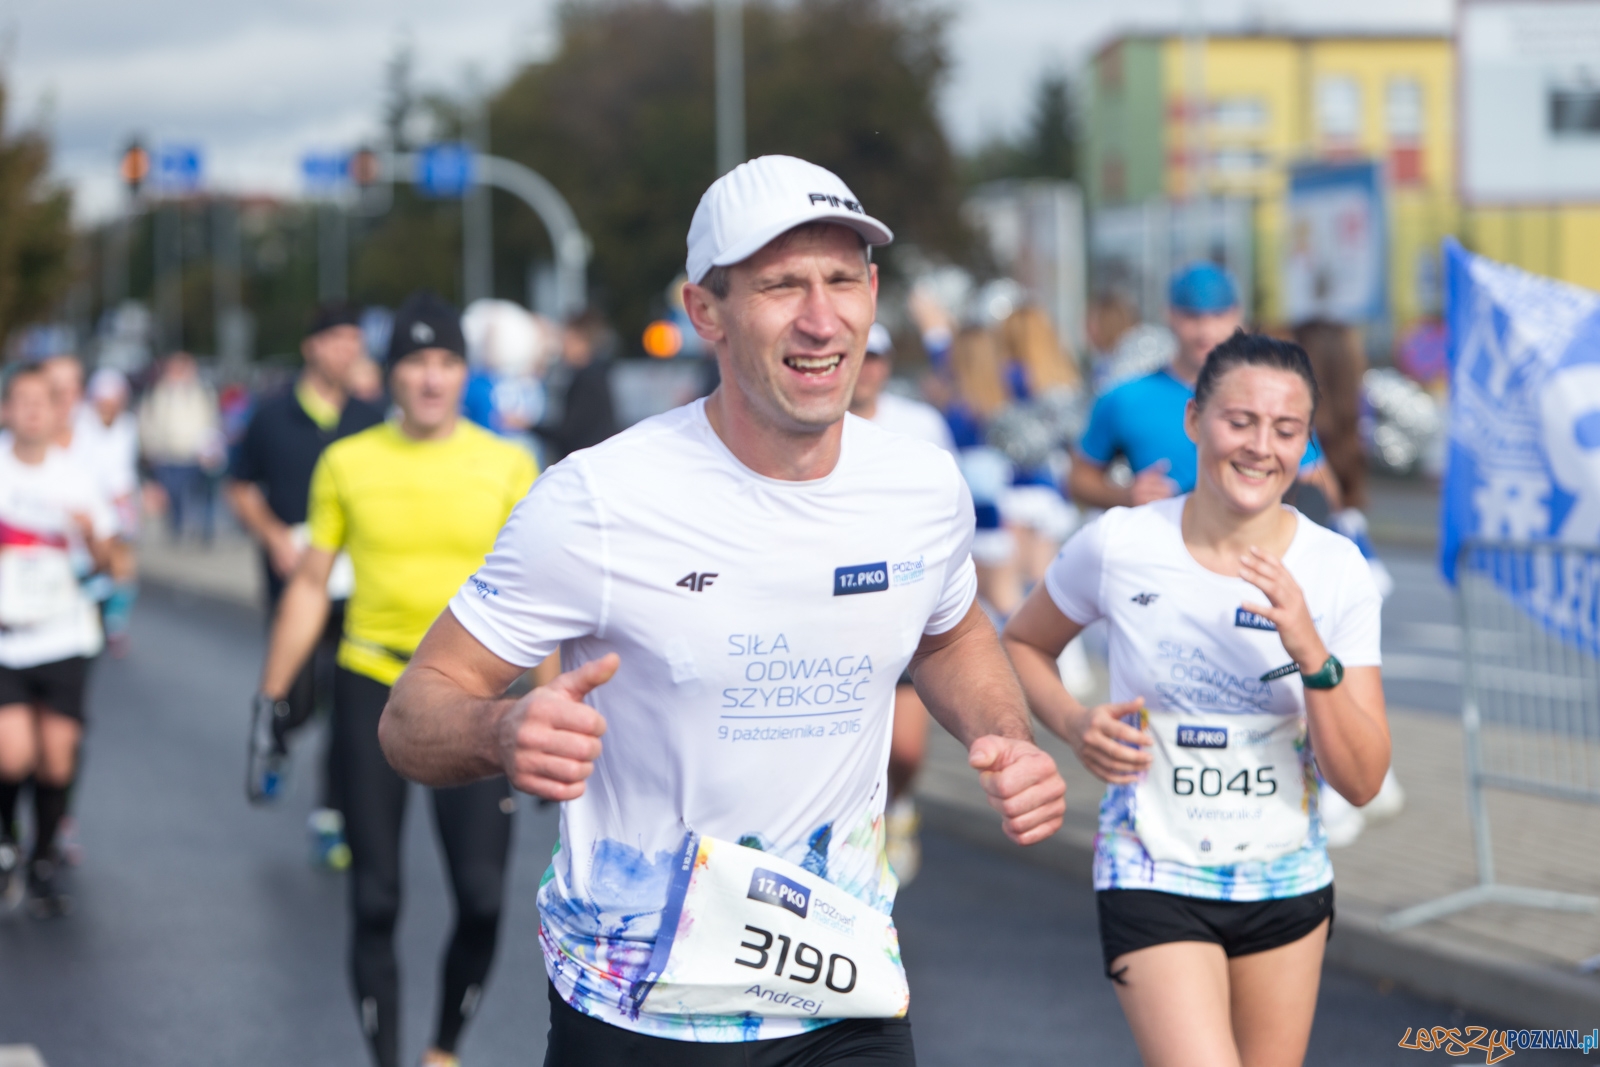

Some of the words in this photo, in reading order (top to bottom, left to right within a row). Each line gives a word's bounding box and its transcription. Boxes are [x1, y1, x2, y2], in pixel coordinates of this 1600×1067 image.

[676, 571, 719, 592] 4F
[728, 633, 790, 656] SIŁA
[745, 655, 873, 682] ODWAGA
[722, 677, 870, 708] SZYBKOŚĆ
[718, 725, 729, 740] 9
[732, 723, 825, 743] października
[828, 718, 861, 736] 2016
[1173, 766, 1278, 797] 6045
[734, 924, 858, 994] 3190
[744, 984, 824, 1016] Andrzej
